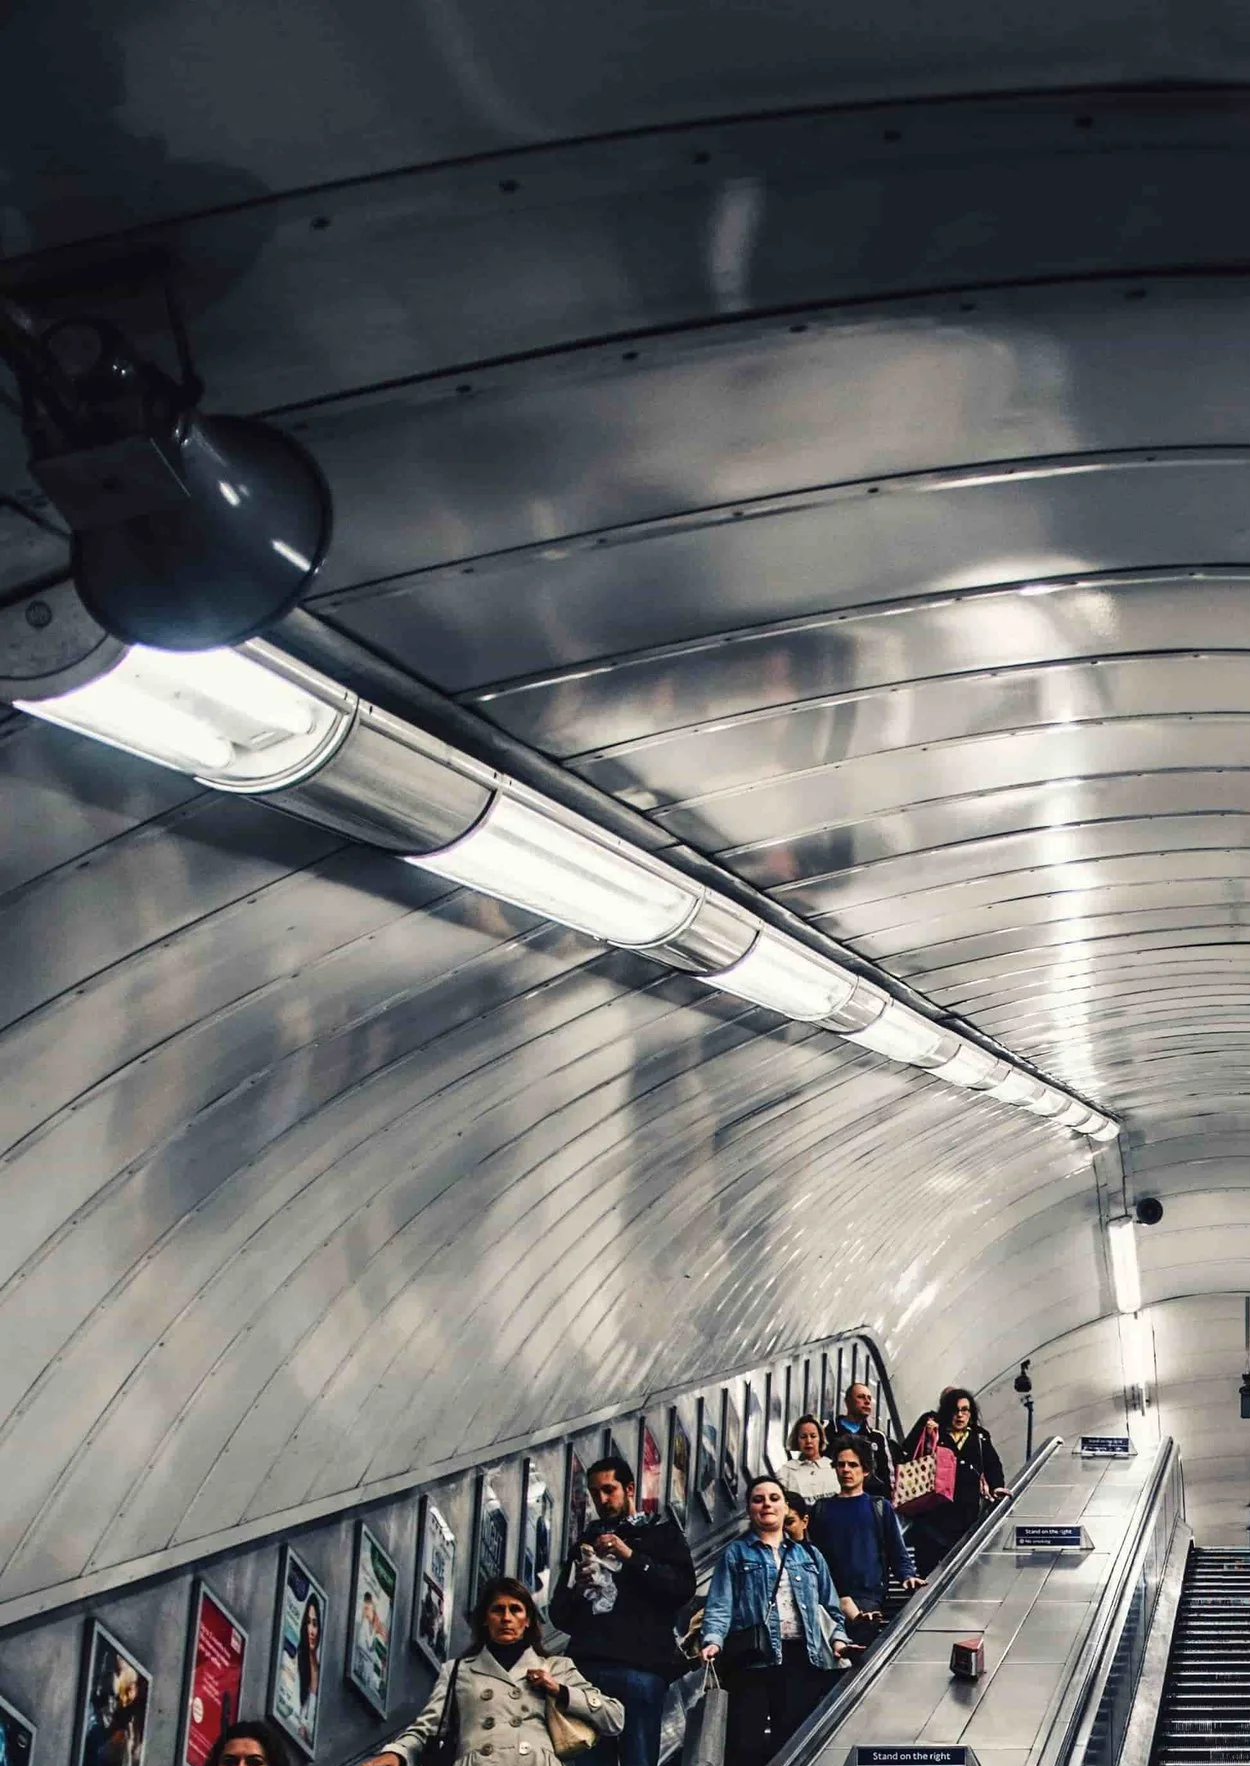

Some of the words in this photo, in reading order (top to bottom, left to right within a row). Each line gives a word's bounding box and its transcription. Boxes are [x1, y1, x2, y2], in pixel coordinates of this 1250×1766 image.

[872, 1752, 898, 1761] Stand
[912, 1752, 928, 1761] the
[929, 1752, 951, 1762] right
